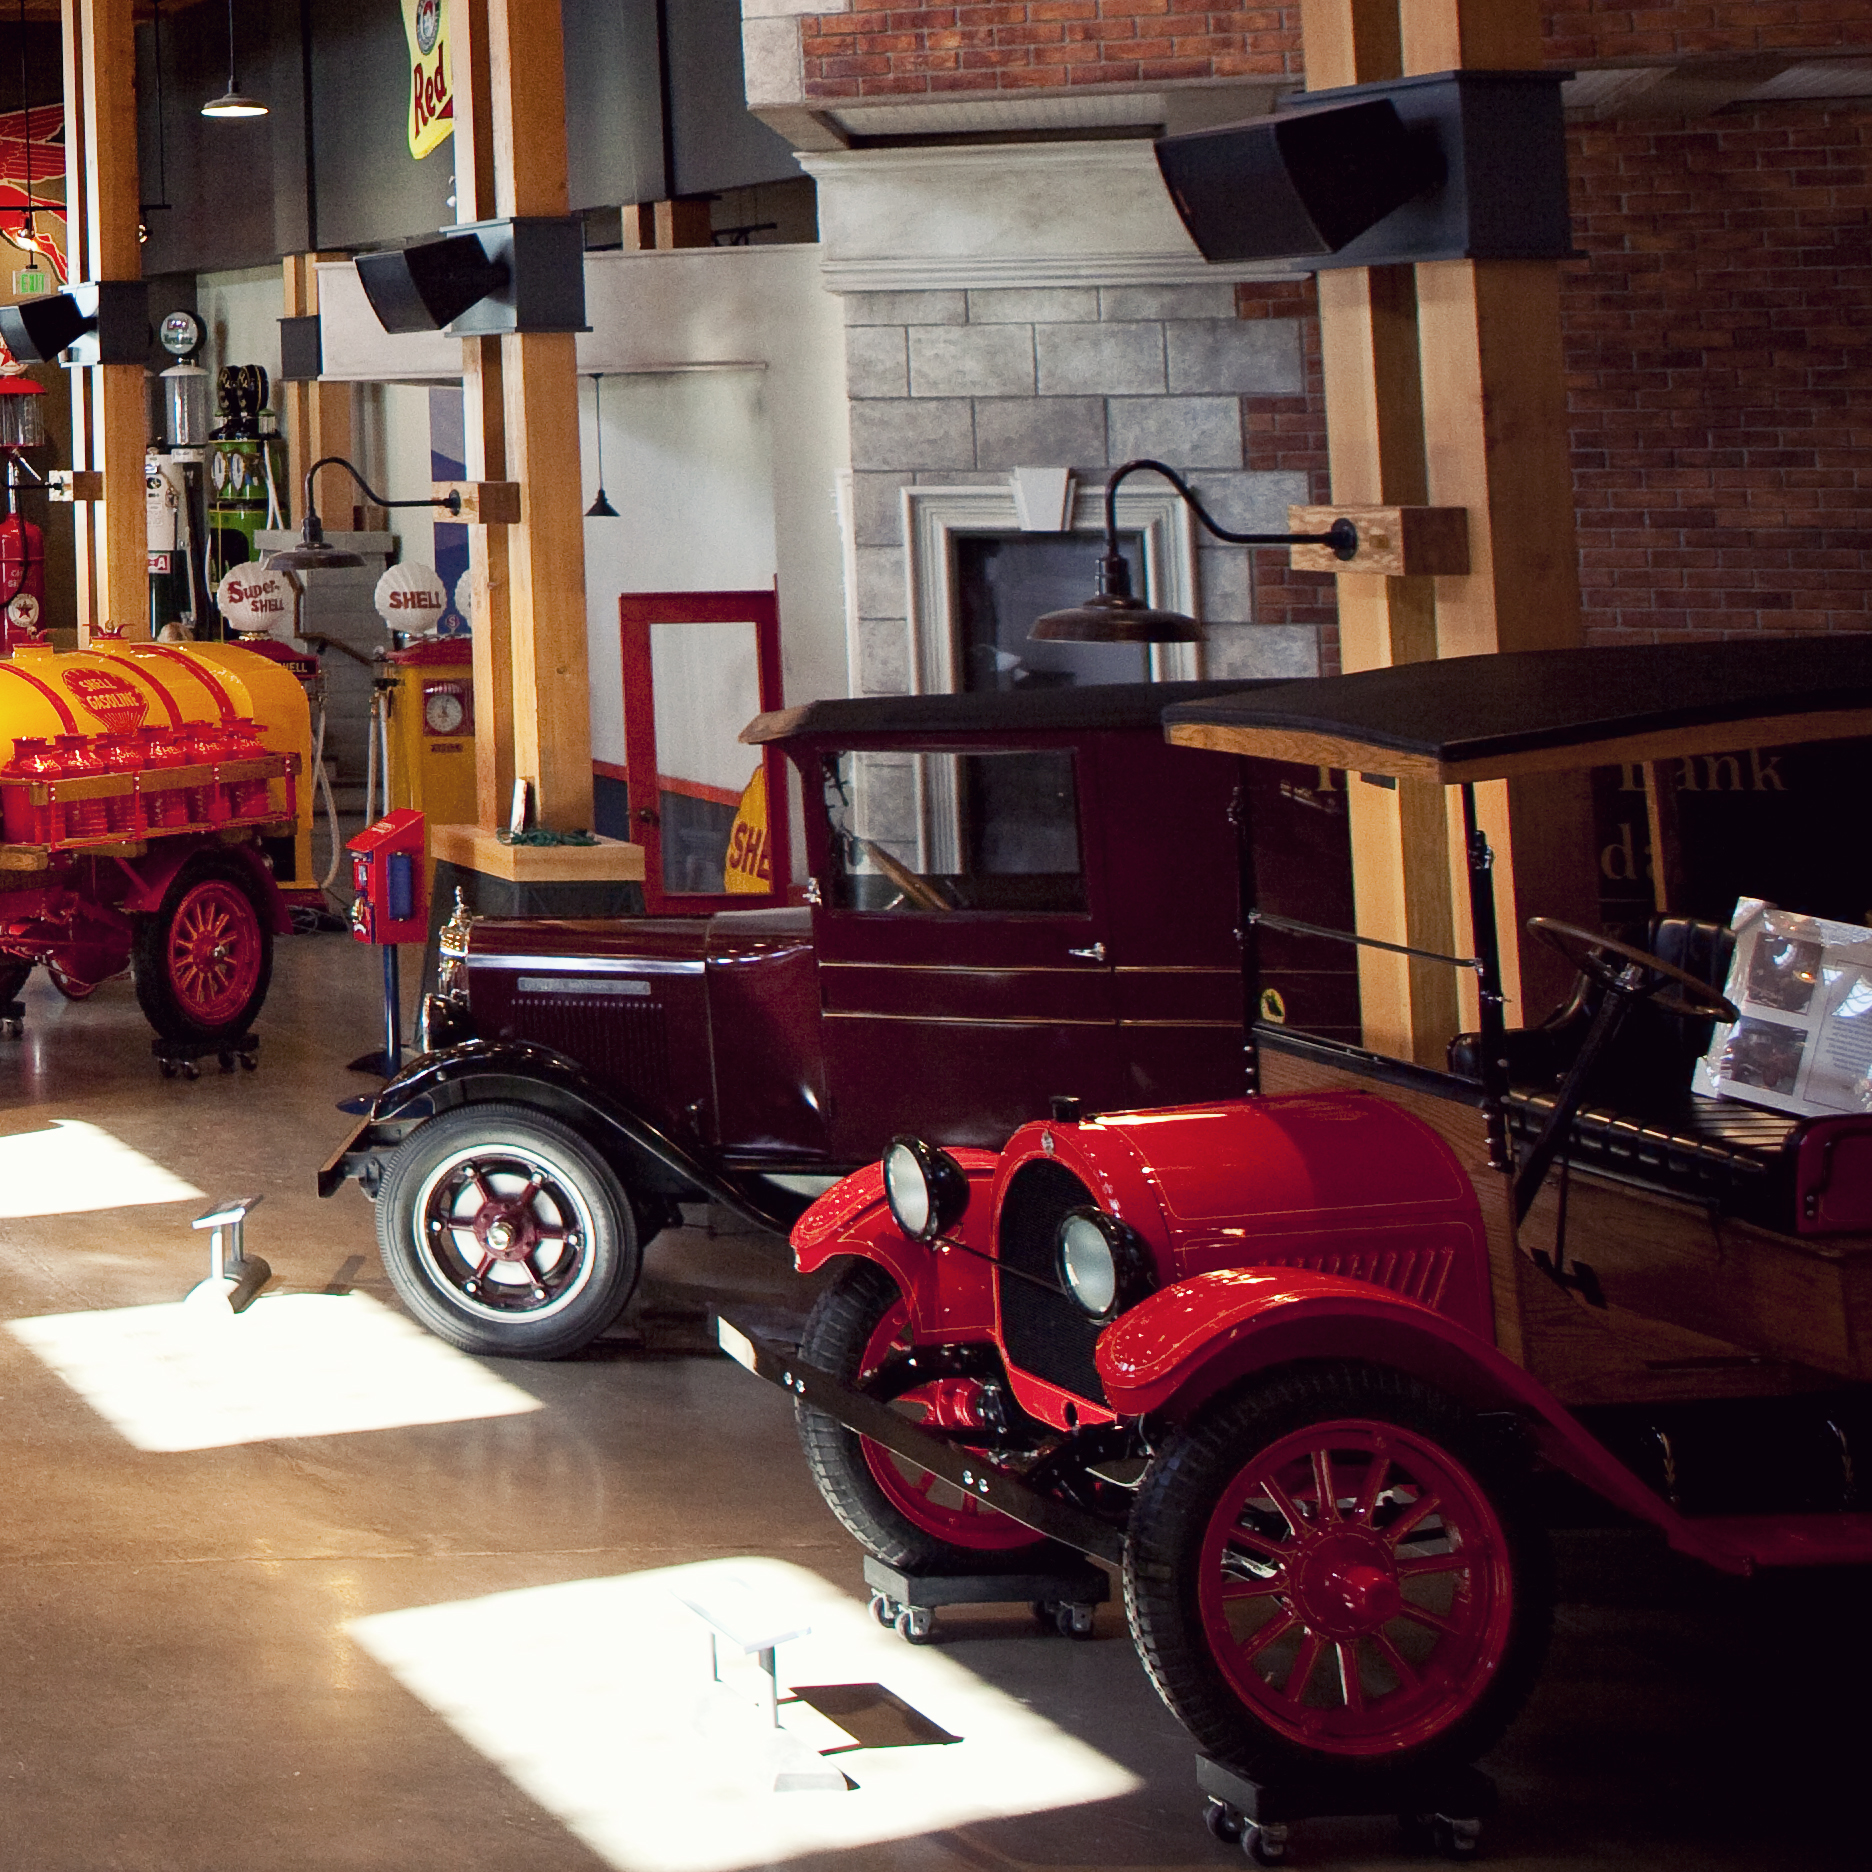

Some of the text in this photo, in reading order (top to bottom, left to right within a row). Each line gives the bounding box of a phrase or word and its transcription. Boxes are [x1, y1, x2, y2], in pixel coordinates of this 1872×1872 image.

[413, 40, 448, 140] Red
[20, 273, 46, 294] EXIT
[227, 579, 281, 605] Super-
[388, 590, 442, 610] SHELL
[251, 598, 286, 613] SHELL
[79, 678, 118, 692] SHELL
[85, 691, 141, 712] GASOLINE
